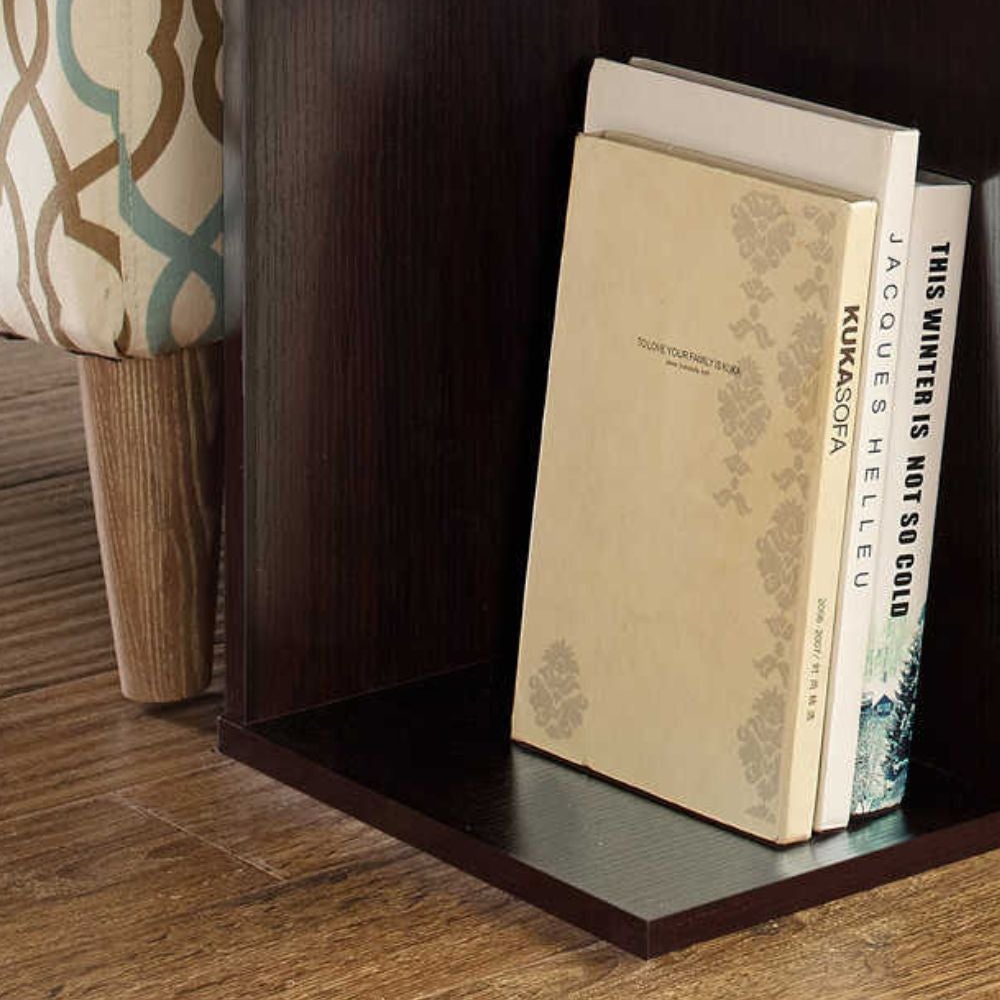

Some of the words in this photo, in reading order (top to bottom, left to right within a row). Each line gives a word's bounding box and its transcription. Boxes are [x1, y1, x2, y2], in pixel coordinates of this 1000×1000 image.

[926, 242, 950, 300] THIS
[872, 232, 903, 414] JACQUES
[914, 308, 943, 406] WINTER
[910, 415, 930, 439] IS
[903, 456, 925, 503] NOT
[854, 439, 882, 588] HELLEU
[898, 512, 919, 545] SO
[890, 554, 915, 617] COLD
